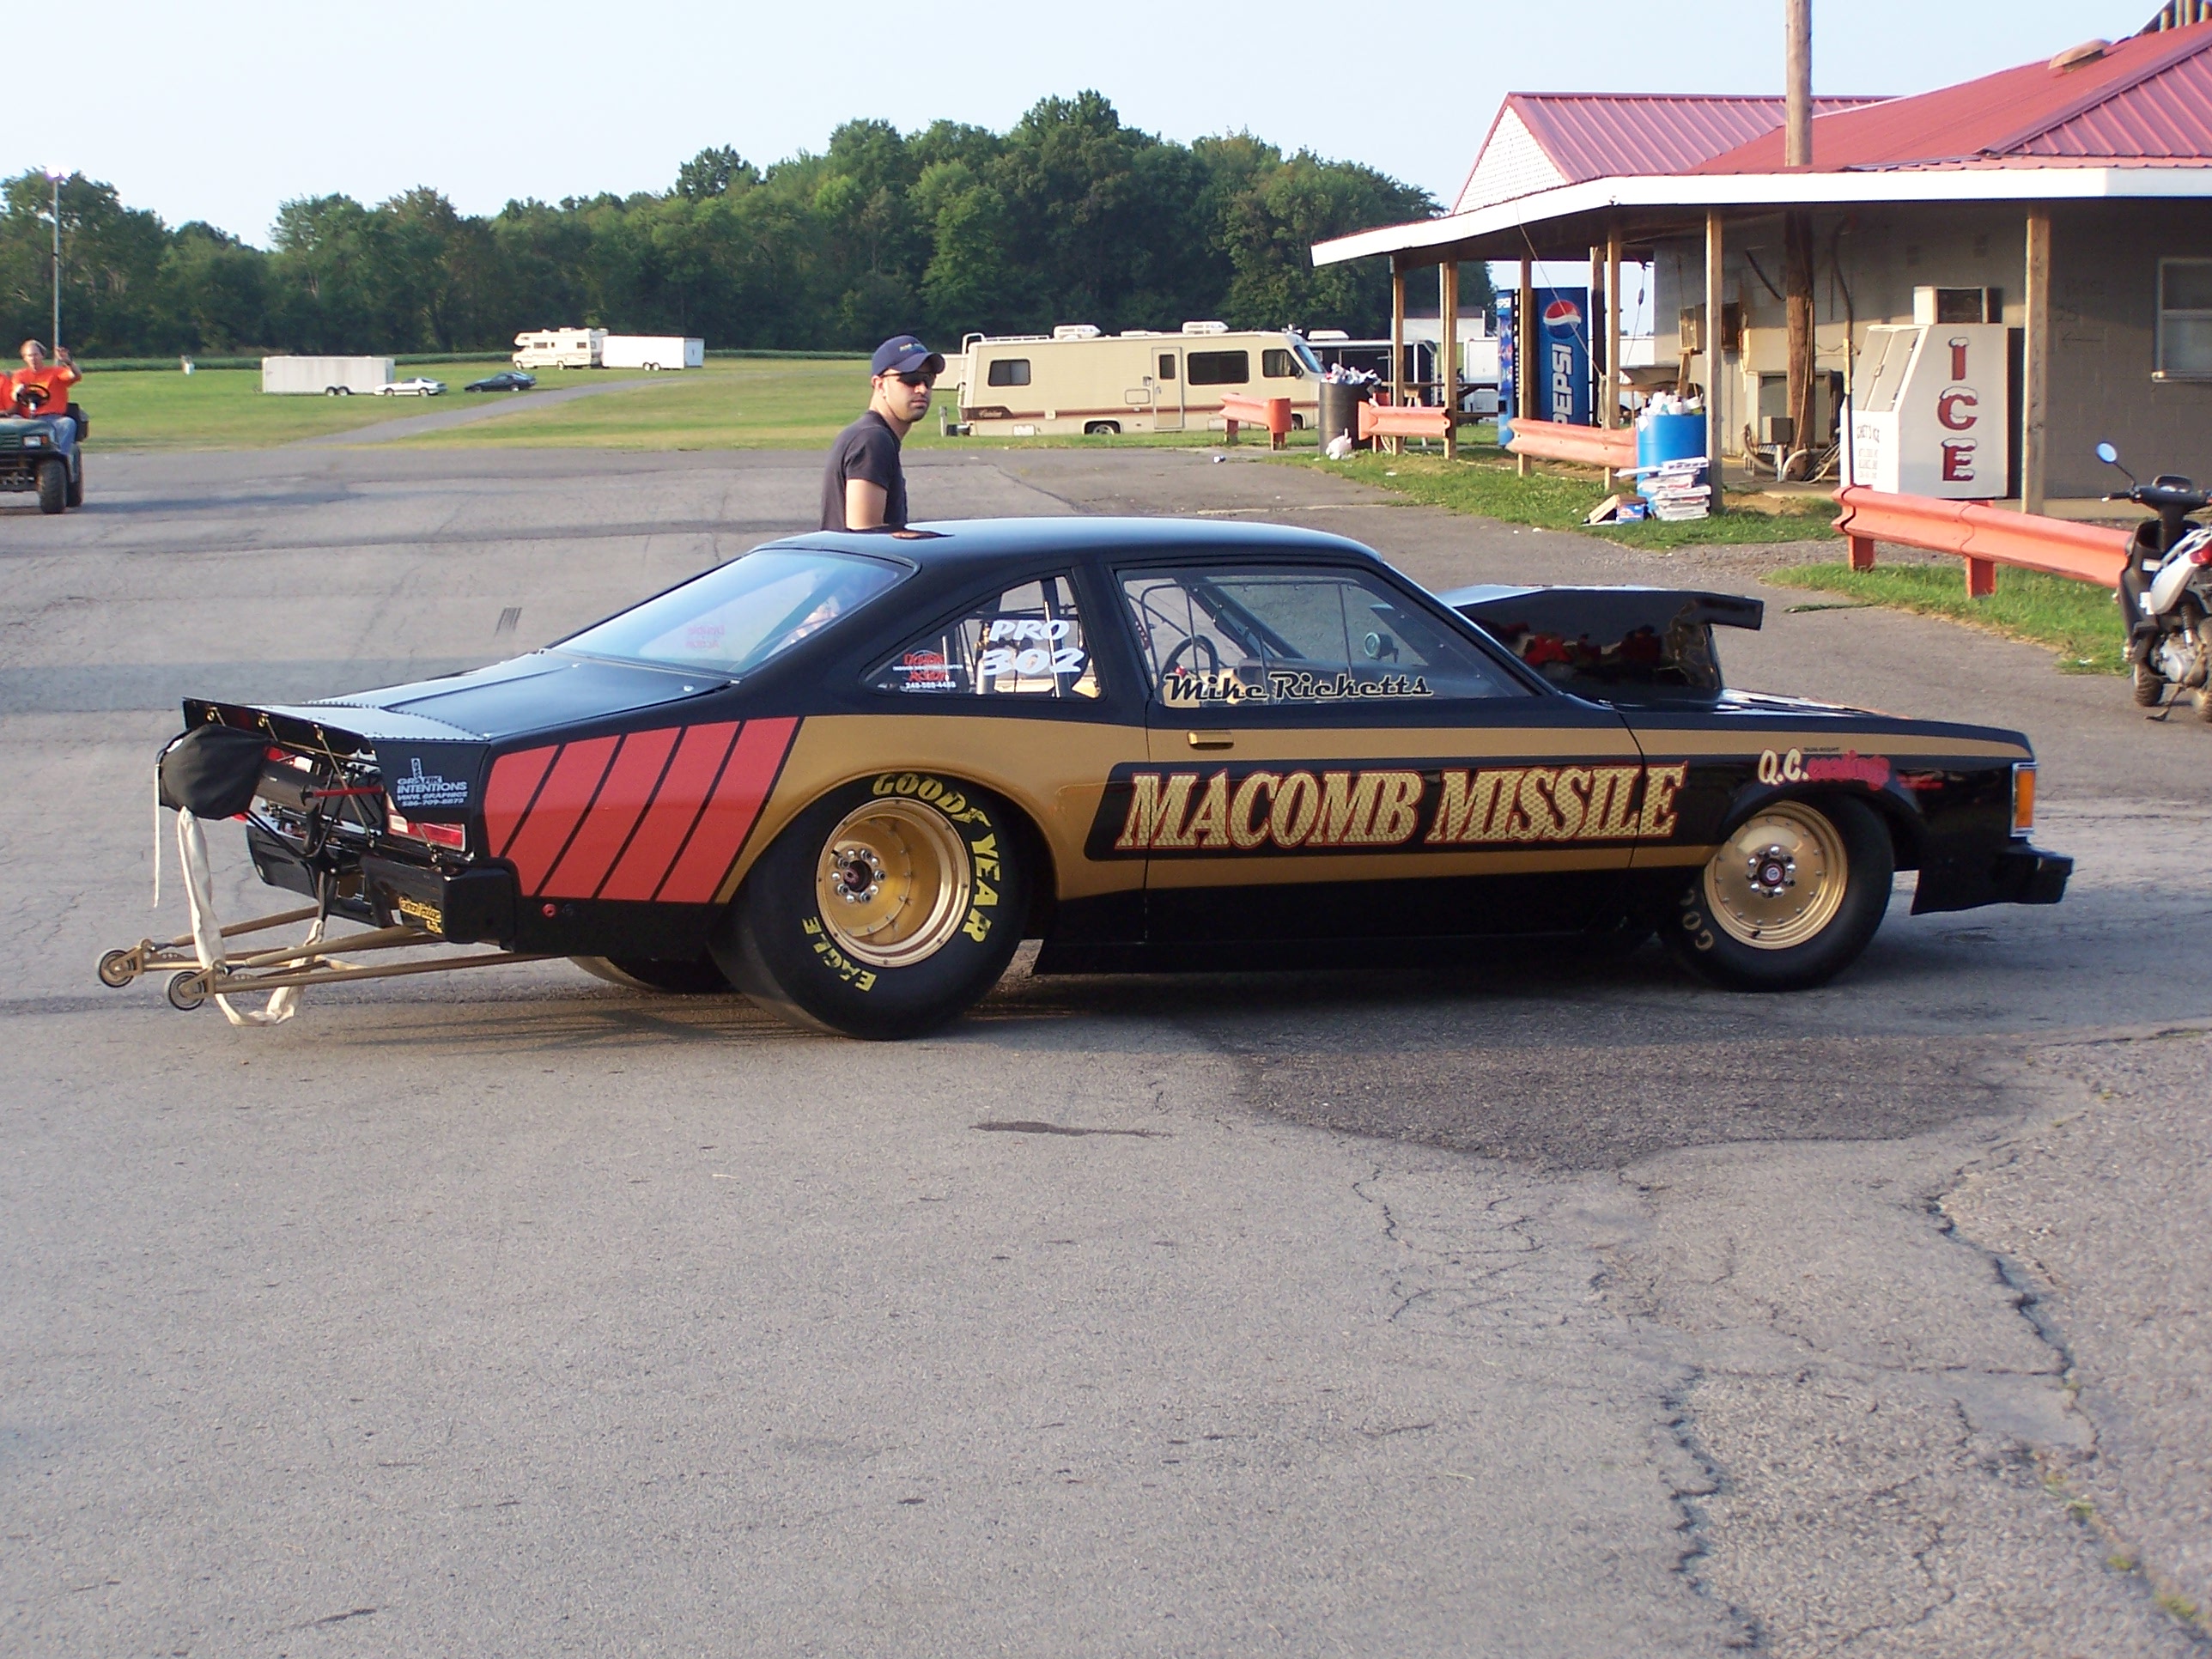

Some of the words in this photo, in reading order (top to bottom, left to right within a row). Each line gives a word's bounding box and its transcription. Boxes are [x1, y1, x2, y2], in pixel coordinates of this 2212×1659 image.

[1936, 337, 1978, 482] ICE
[988, 619, 1070, 641] PRO
[983, 647, 1085, 676] 302
[1164, 672, 1268, 702] Mike
[1268, 671, 1434, 700] Ricketts
[1758, 748, 1810, 786] Q.C.
[397, 781, 468, 794] INTENTIONS
[1115, 768, 1425, 849] MACOMB
[1424, 759, 1689, 843] MISSILE
[801, 915, 877, 993] EAGLE
